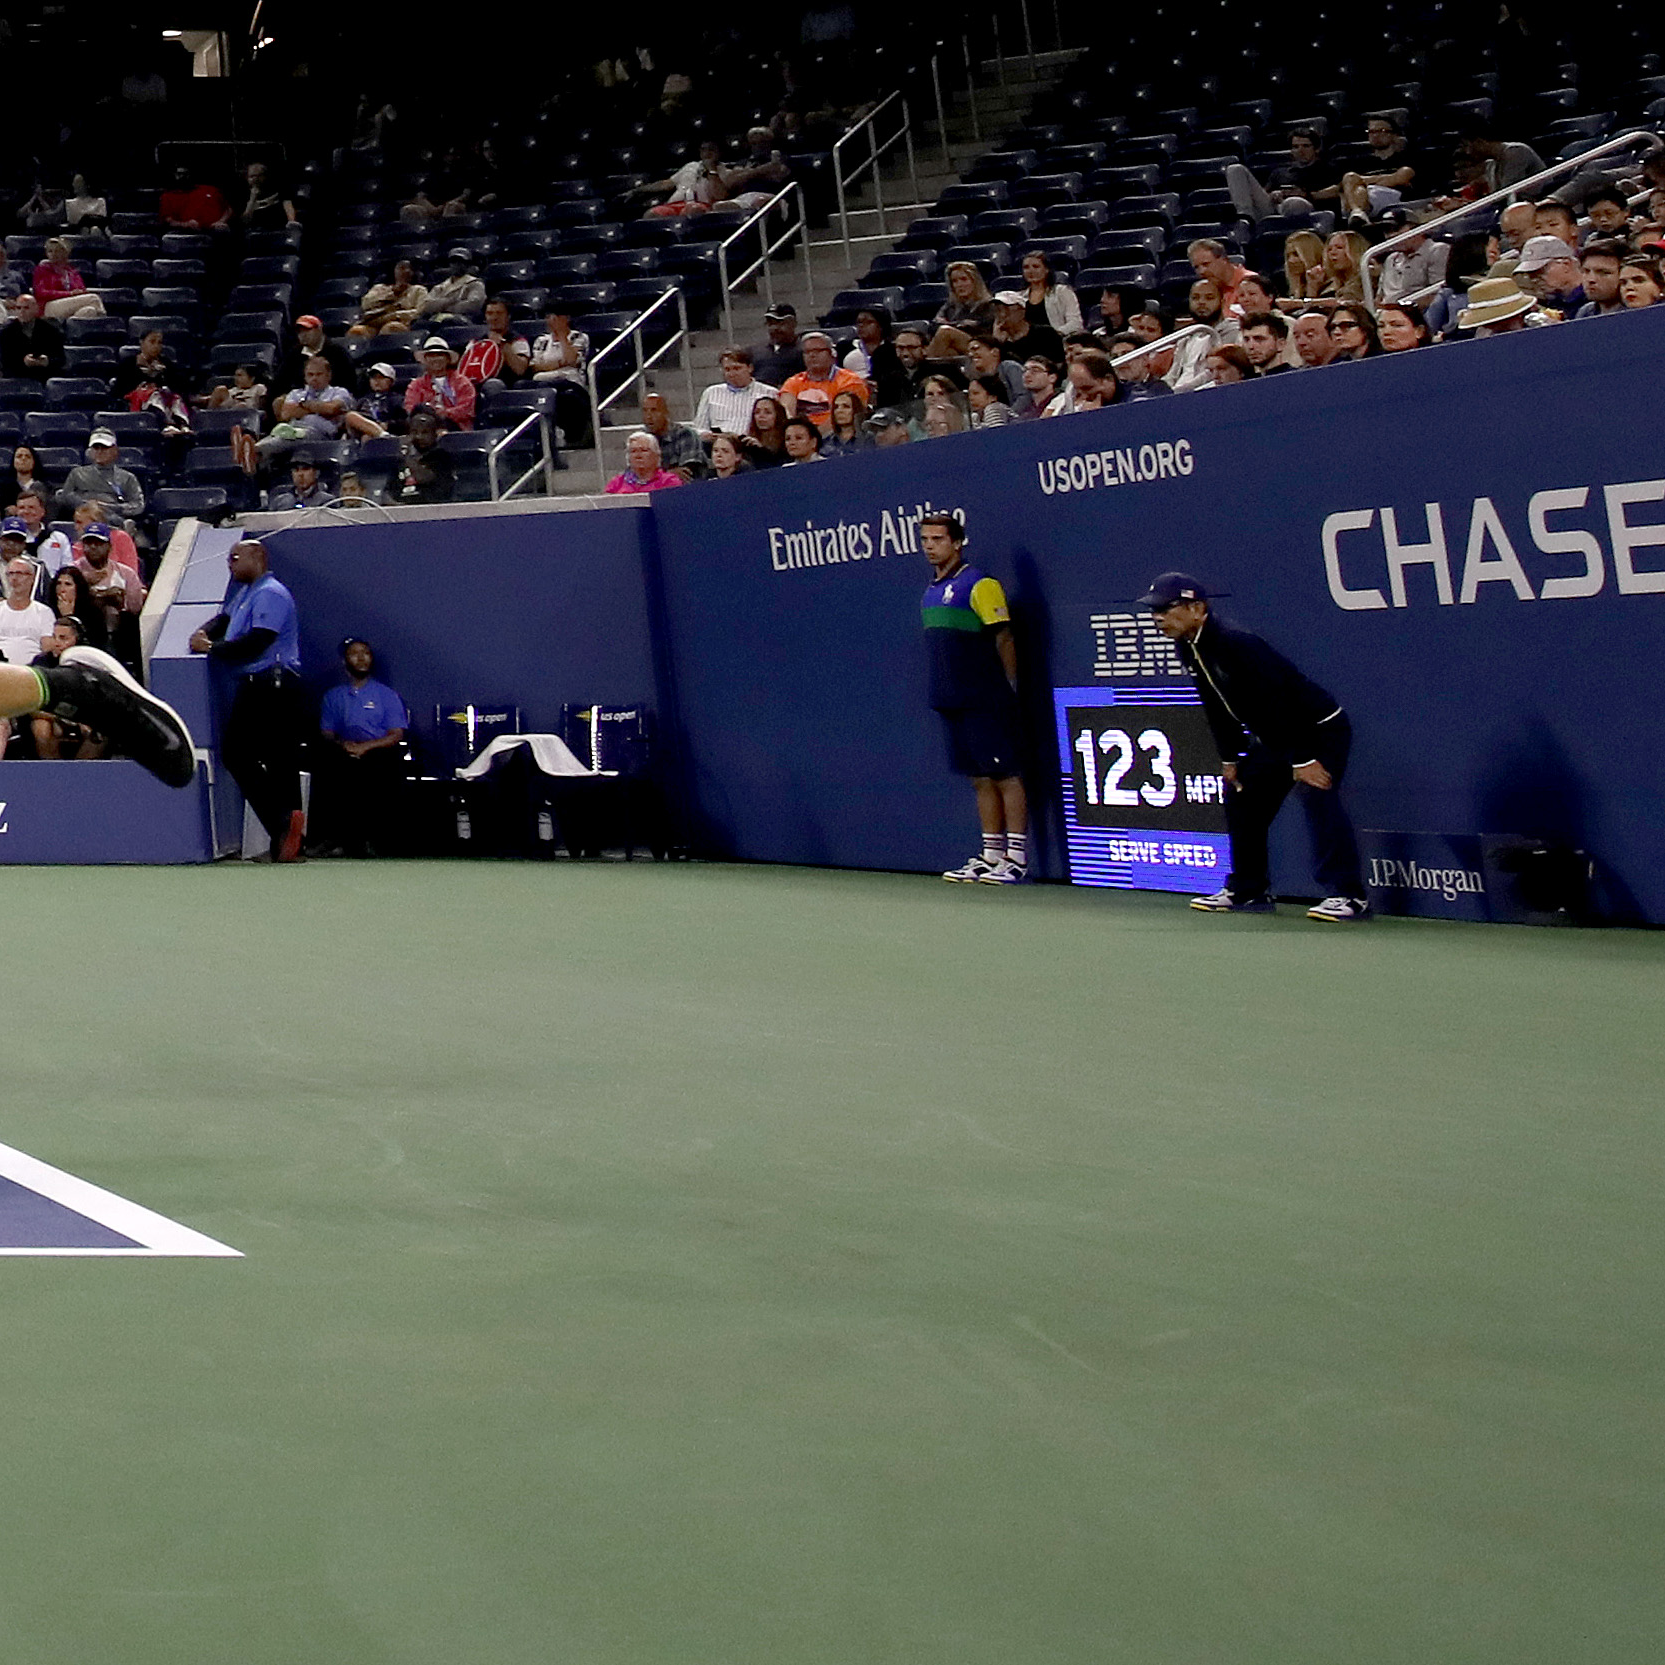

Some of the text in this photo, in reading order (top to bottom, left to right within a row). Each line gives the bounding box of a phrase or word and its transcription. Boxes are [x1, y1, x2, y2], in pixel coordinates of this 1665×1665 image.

[1037, 438, 1195, 495] USOPEN.ORG
[768, 519, 873, 571] Emirates
[1321, 478, 1665, 611] CHASE
[1090, 612, 1197, 677] IBM
[1074, 728, 1178, 807] 123
[1185, 774, 1224, 804] MP
[1108, 839, 1217, 868] SERVE SPEED
